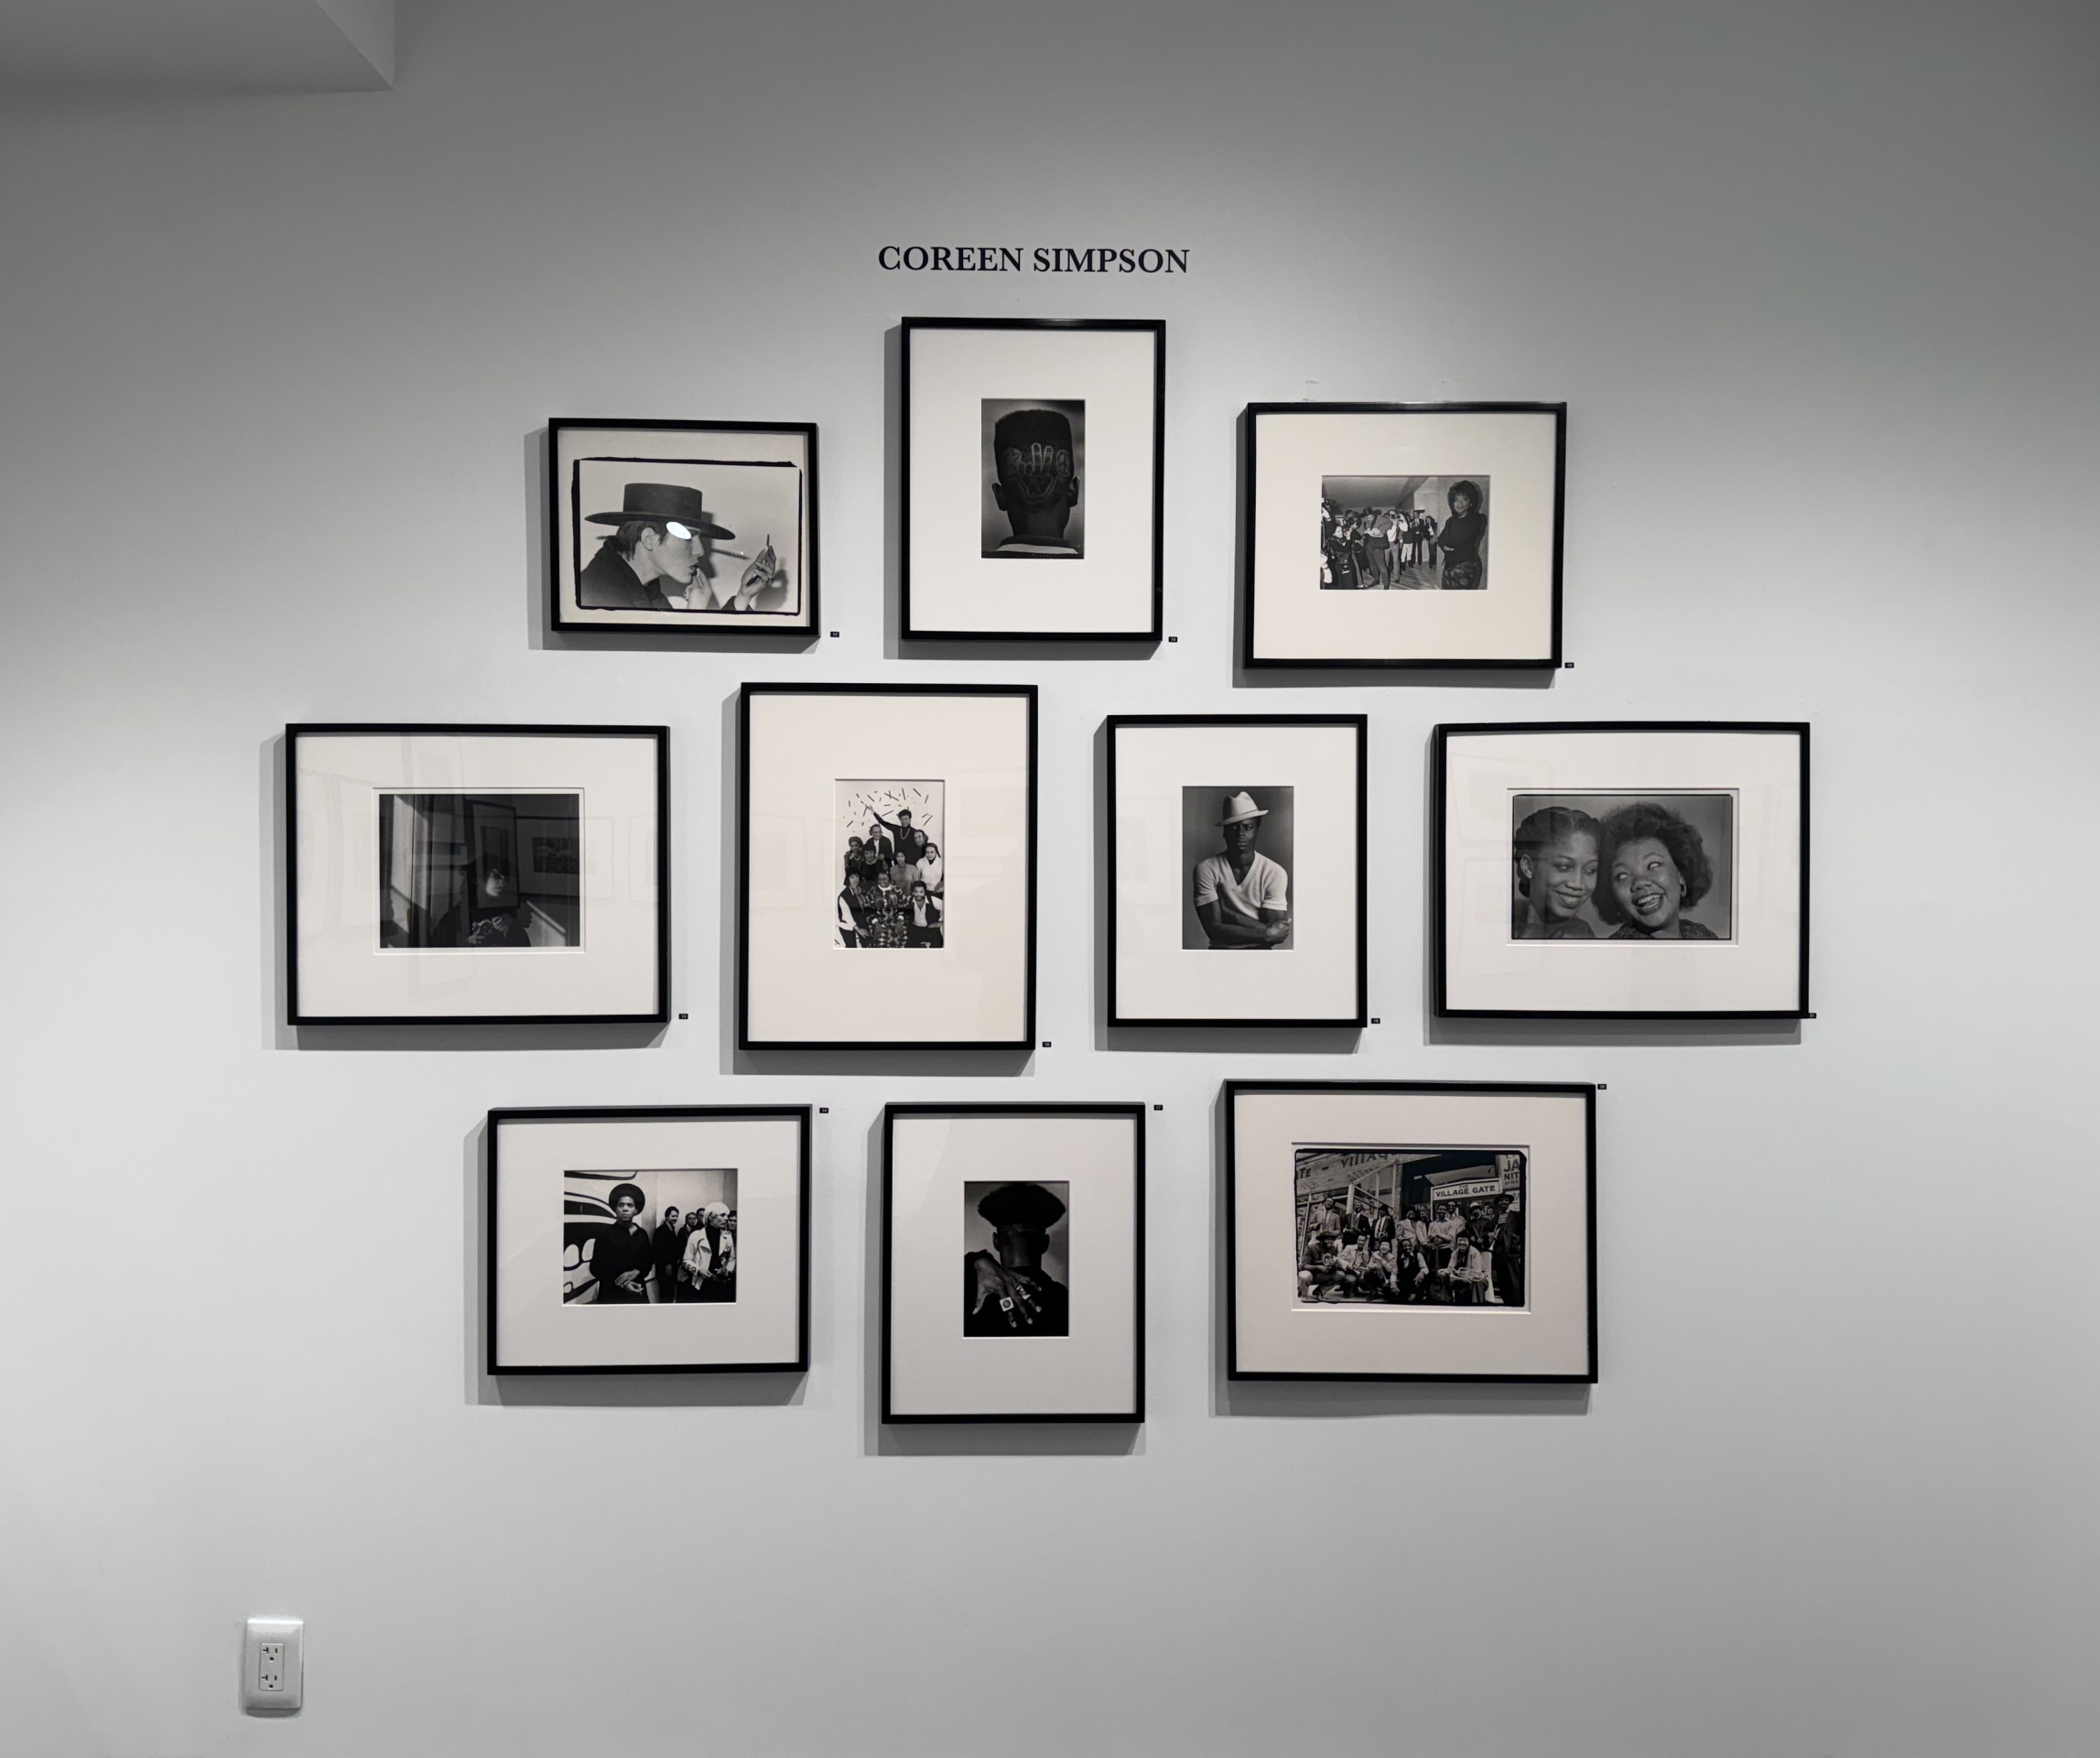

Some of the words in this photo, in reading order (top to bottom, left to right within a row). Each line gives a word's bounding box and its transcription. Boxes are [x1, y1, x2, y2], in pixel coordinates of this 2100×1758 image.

[878, 245, 1023, 271] COREEN
[1034, 247, 1190, 273] SIMPSON
[1436, 1188, 1469, 1198] VILLAGE
[1472, 1185, 1496, 1194] GATE
